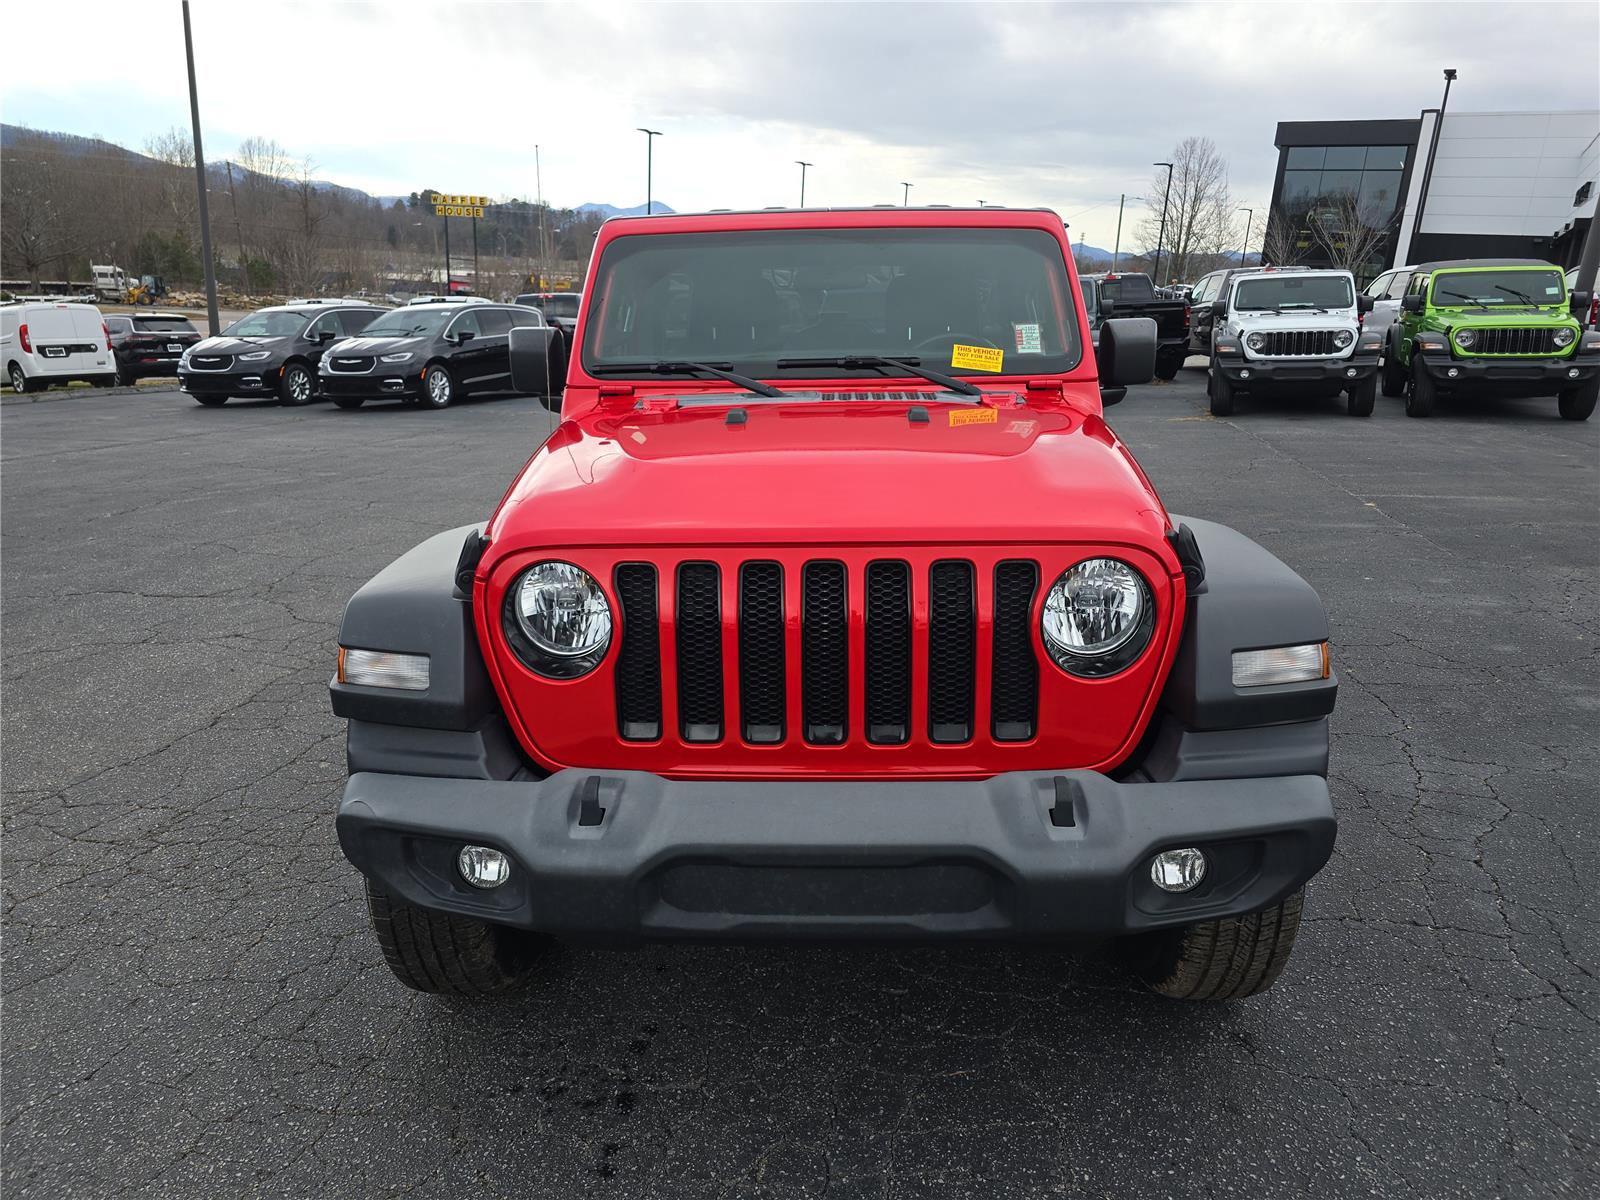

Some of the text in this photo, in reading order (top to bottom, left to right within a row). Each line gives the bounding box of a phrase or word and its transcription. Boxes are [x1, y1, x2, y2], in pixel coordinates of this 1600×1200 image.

[432, 195, 486, 205] WAFFLE
[437, 206, 481, 216] HOUSE
[973, 348, 1000, 356] VEHICLE
